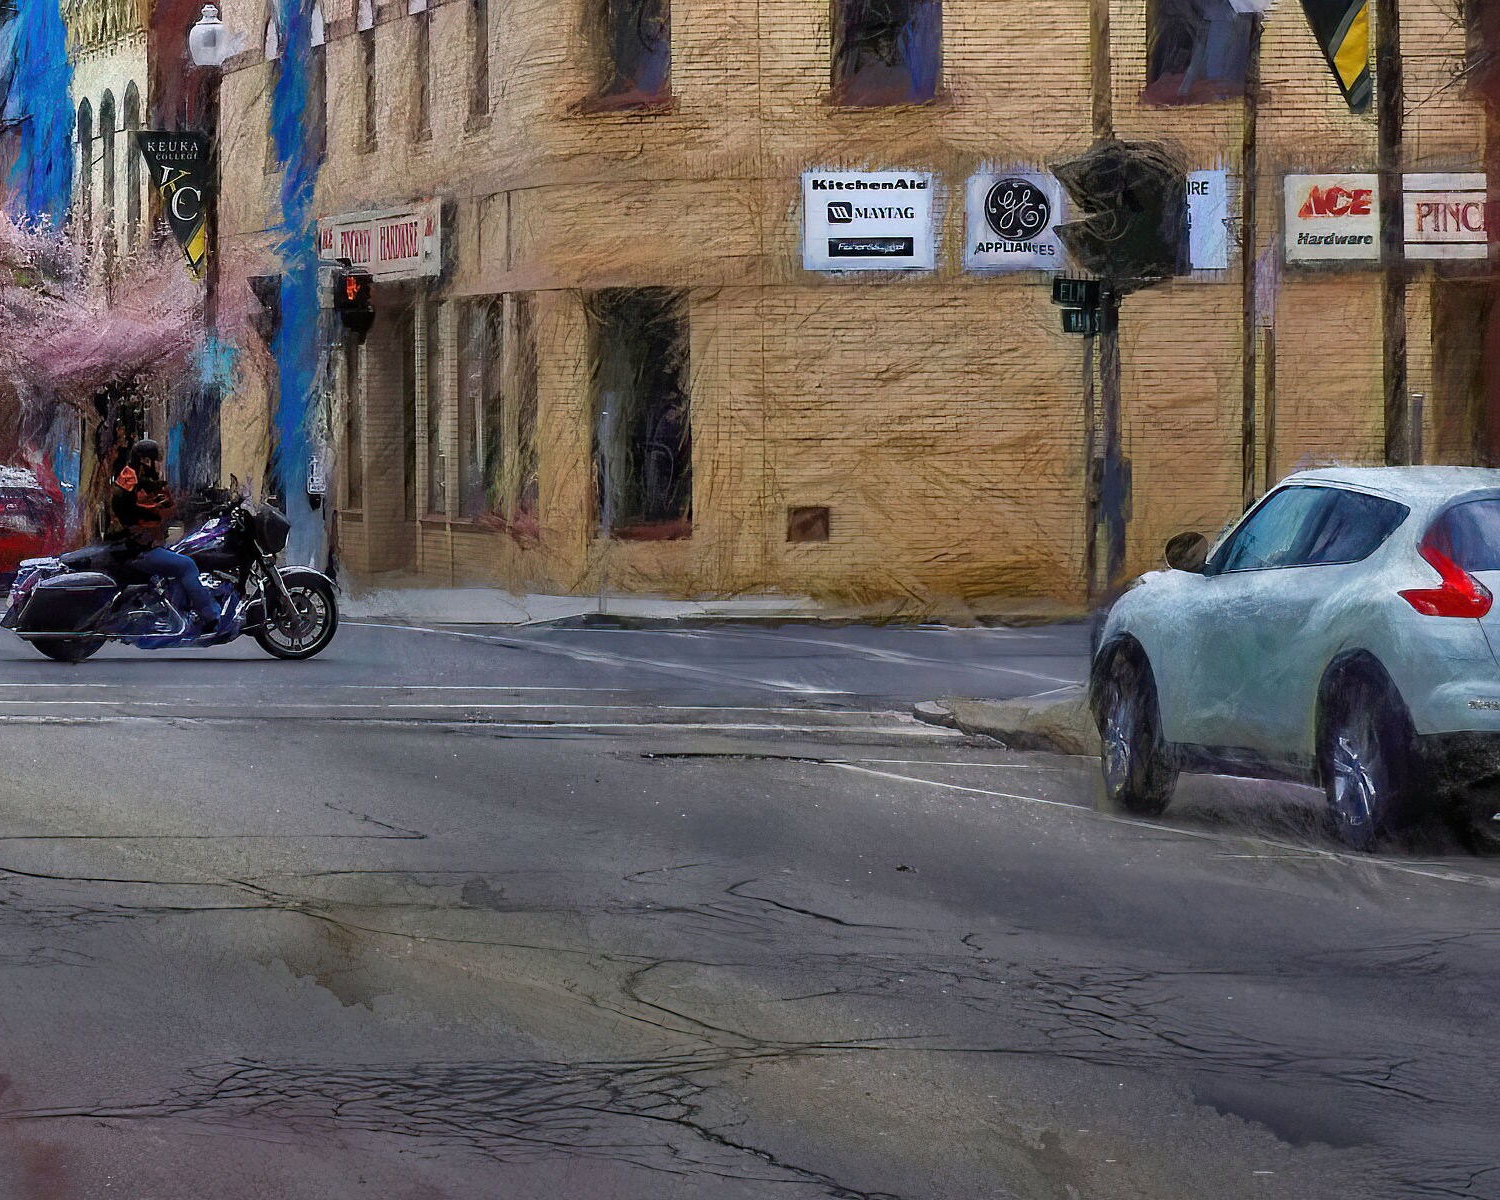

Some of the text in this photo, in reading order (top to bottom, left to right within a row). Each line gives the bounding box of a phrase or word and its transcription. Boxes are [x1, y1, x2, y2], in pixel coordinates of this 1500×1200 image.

[147, 141, 199, 152] KEUKA
[812, 179, 928, 191] KitchenAid
[1298, 185, 1373, 218] ACE
[855, 207, 915, 219] MAYTAG
[1298, 232, 1374, 245] Hardware
[974, 241, 1055, 256] APPLIANCES
